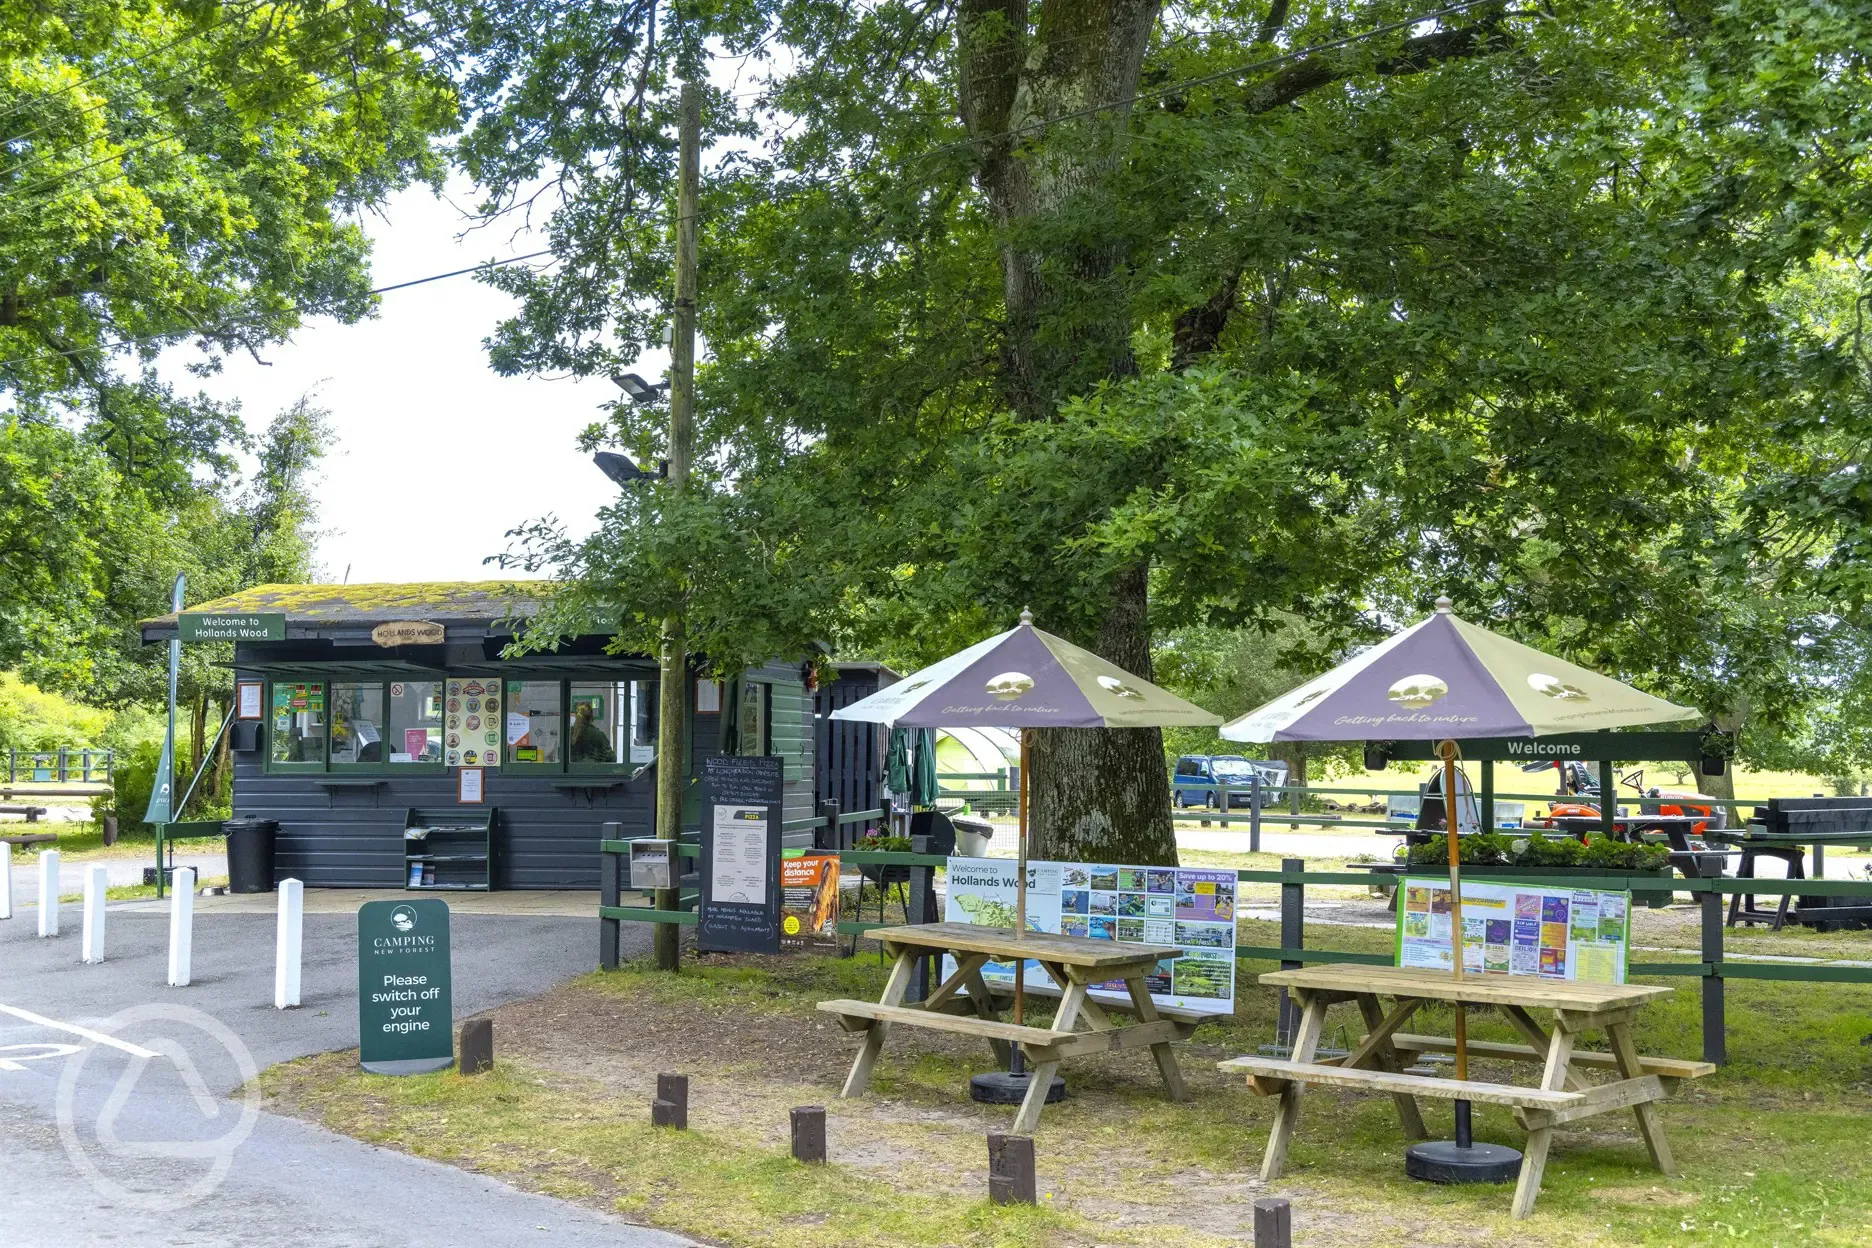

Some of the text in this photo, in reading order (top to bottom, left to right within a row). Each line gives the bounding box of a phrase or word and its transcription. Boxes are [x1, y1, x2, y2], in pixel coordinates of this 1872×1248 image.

[203, 617, 260, 626] Welcome to
[195, 628, 268, 637] Hollands Wood
[377, 628, 443, 637] HOLLANDS WOOD
[942, 706, 983, 715] Getting
[985, 703, 1010, 712] back
[1011, 704, 1022, 712] to
[1335, 713, 1478, 727] Getting back to nature
[1508, 741, 1581, 754] Welcome
[783, 860, 819, 869] Keep your
[951, 864, 998, 874] Welcome to
[784, 869, 815, 877] distance
[1178, 872, 1196, 880] Save
[1216, 874, 1233, 882] 20%
[951, 875, 1000, 887] Hollands
[373, 935, 435, 947] CAMPING
[384, 975, 427, 986] Please
[372, 987, 440, 1003] switch off
[390, 1005, 421, 1019] your
[382, 1020, 430, 1034] engine
